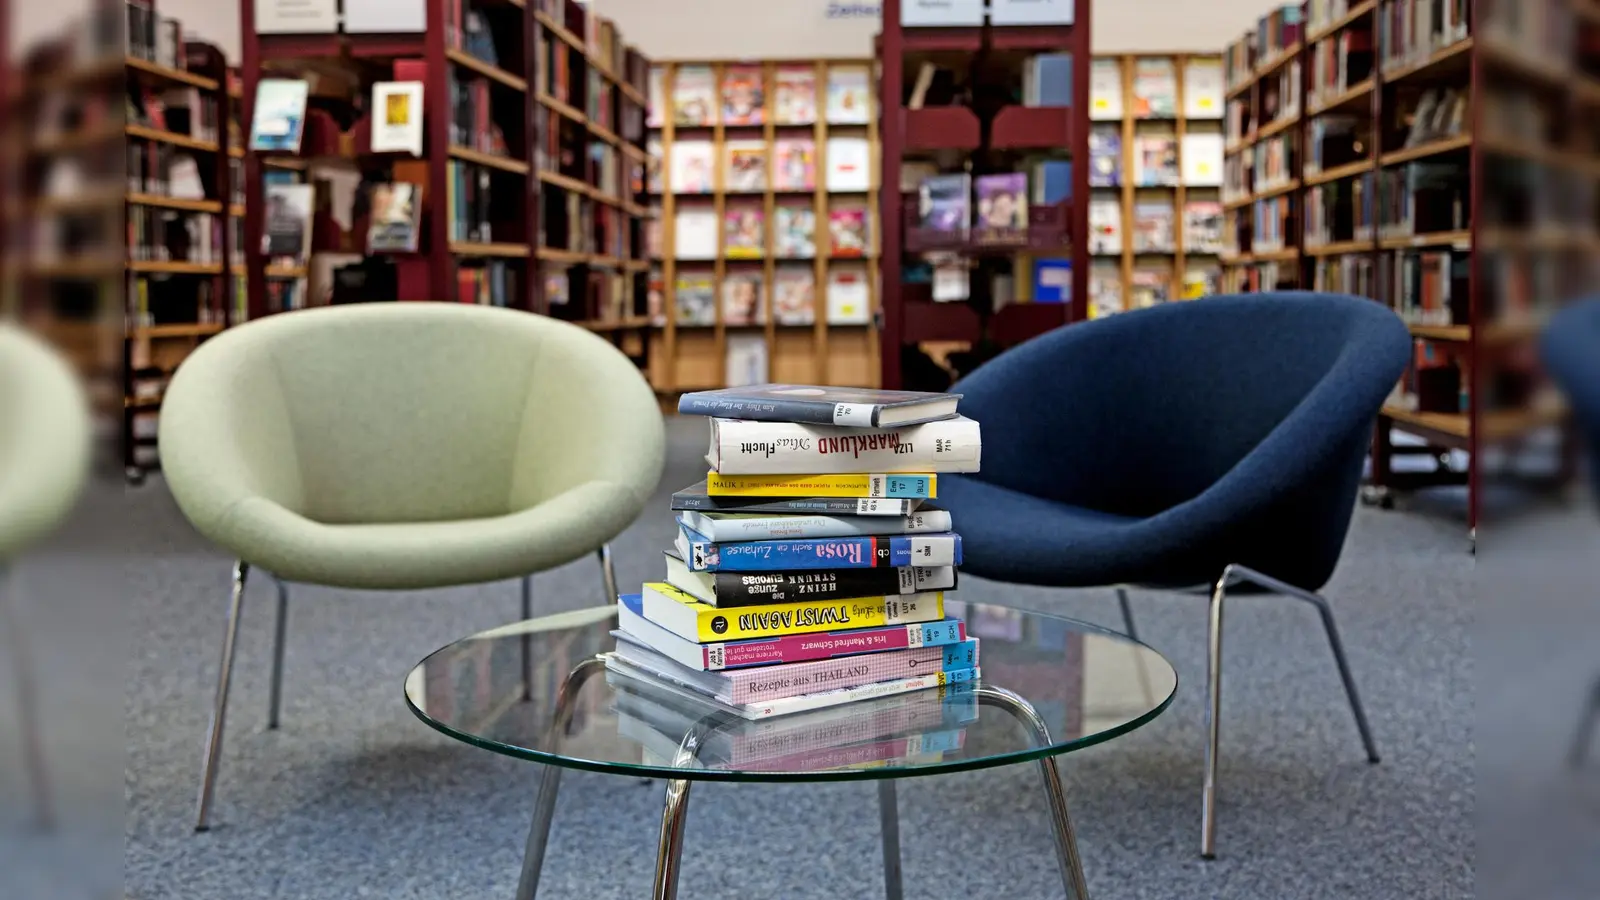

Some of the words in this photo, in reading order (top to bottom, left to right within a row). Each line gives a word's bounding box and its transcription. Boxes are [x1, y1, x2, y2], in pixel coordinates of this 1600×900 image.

[741, 442, 776, 458] Flucht
[776, 438, 811, 451] Mias
[818, 432, 900, 458] MARKLUND
[894, 442, 914, 454] LIZA
[713, 481, 737, 489] MALIK
[872, 478, 880, 497] Fernweh
[861, 499, 869, 512] MUE
[742, 520, 769, 531] Fremde
[770, 520, 812, 530] undankbare
[814, 519, 826, 527] Die
[726, 545, 772, 558] Zuhause
[776, 544, 788, 554] ein
[792, 544, 812, 552] sucht
[816, 542, 863, 564] Rosa
[878, 548, 890, 558] cb
[788, 573, 837, 585] STRUNK
[799, 582, 837, 594] HEINZ
[796, 605, 850, 627] TWIST
[853, 604, 875, 619] Lutz
[738, 611, 793, 630] AGAIN
[801, 638, 834, 650] Schwarz
[834, 636, 865, 648] Manfred
[873, 635, 886, 644] Iris
[734, 646, 746, 654] gut
[746, 644, 775, 653] trotzdem
[756, 649, 783, 659] Karriere
[729, 652, 755, 661] machen
[750, 679, 790, 693] Rezepte
[793, 676, 810, 685] aus
[812, 666, 869, 684] THAILAND
